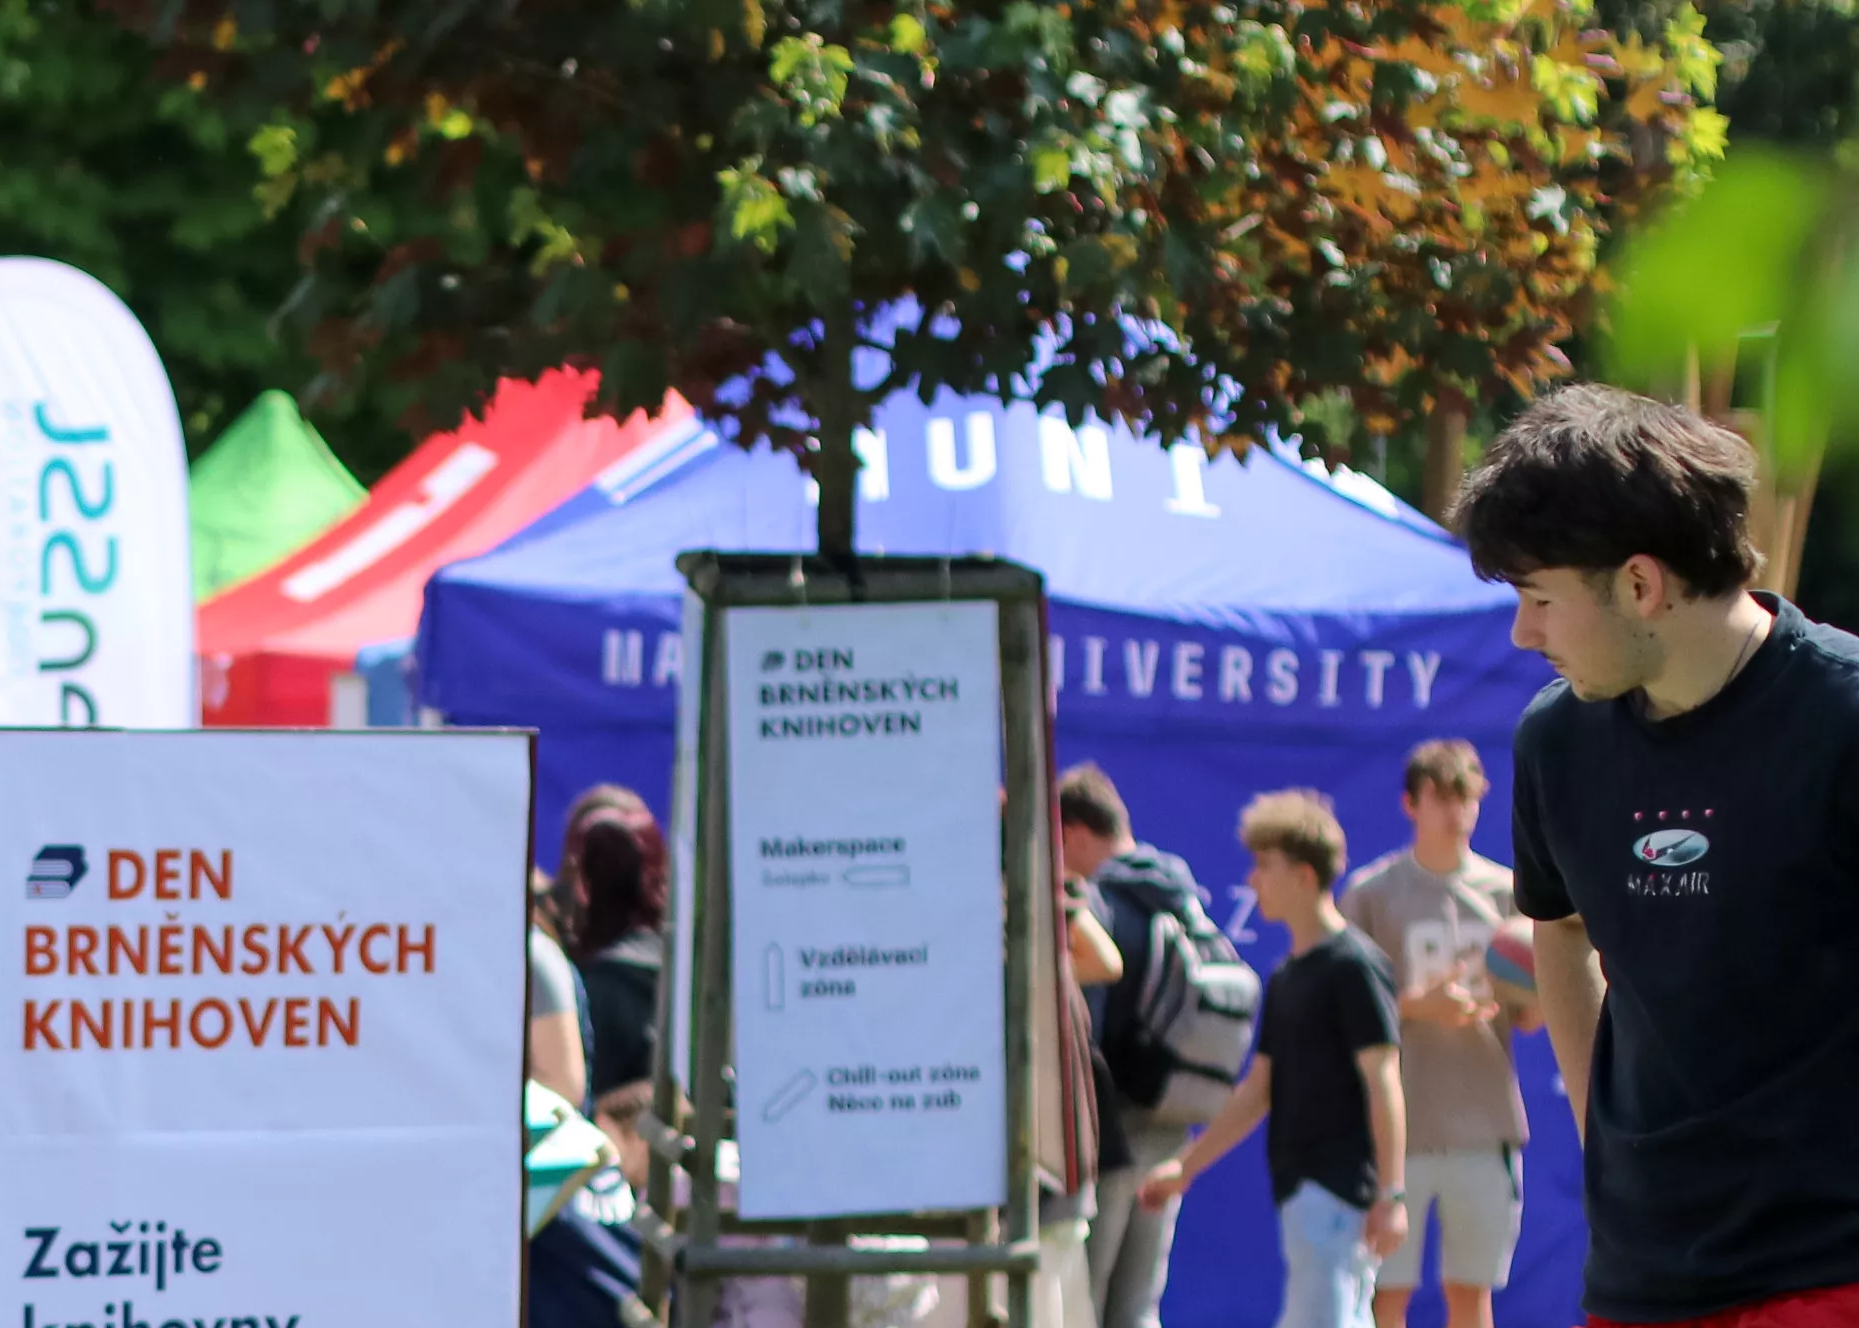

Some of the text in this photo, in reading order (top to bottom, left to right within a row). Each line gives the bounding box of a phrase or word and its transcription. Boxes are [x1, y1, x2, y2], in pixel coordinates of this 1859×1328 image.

[795, 649, 853, 671] DEN
[1048, 634, 1442, 710] IVERSITY
[759, 672, 960, 706] BRNĚNSKÝCH
[760, 712, 921, 739] KNIHOVEN
[759, 836, 906, 860] Makerspace
[107, 849, 232, 900] DEN
[25, 911, 435, 976] BRNĚNSKÝCH
[799, 943, 929, 968] Vzdělávací
[800, 977, 856, 998] zóna
[23, 996, 360, 1049] KNIHOVEN
[827, 1064, 980, 1086] Chill-out zóna
[828, 1090, 962, 1112] Něco na zub
[23, 1221, 222, 1290] Zažijte
